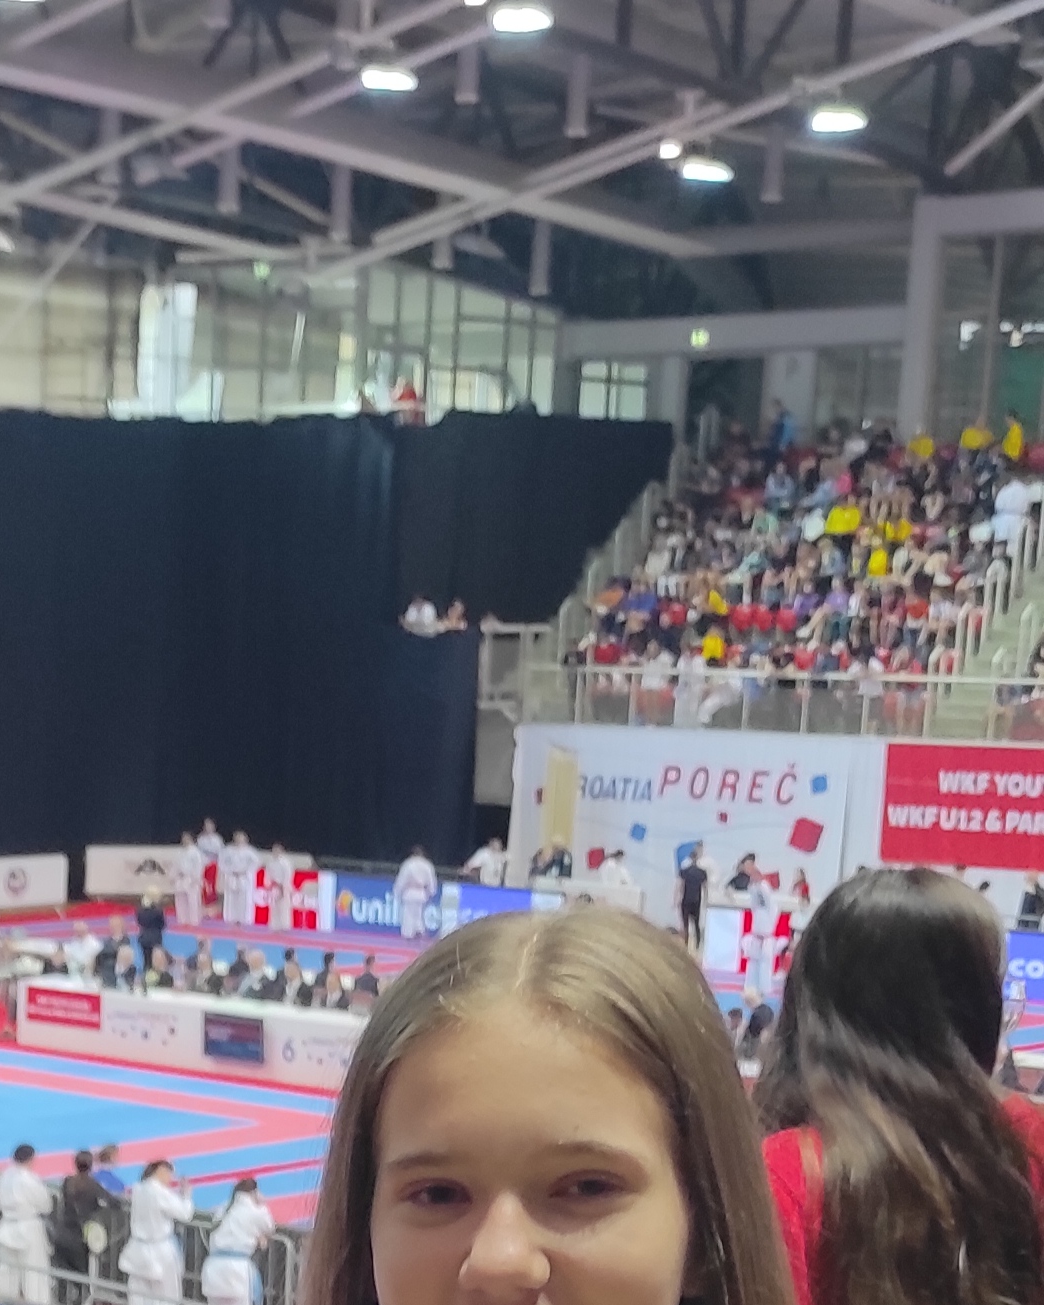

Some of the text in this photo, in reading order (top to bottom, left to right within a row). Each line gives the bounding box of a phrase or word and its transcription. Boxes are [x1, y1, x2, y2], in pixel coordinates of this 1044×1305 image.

[579, 763, 798, 805] ROATIA POREČ
[939, 769, 990, 794] WKF
[887, 803, 937, 829] WKF
[939, 807, 984, 832] U12
[351, 890, 442, 931] unile
